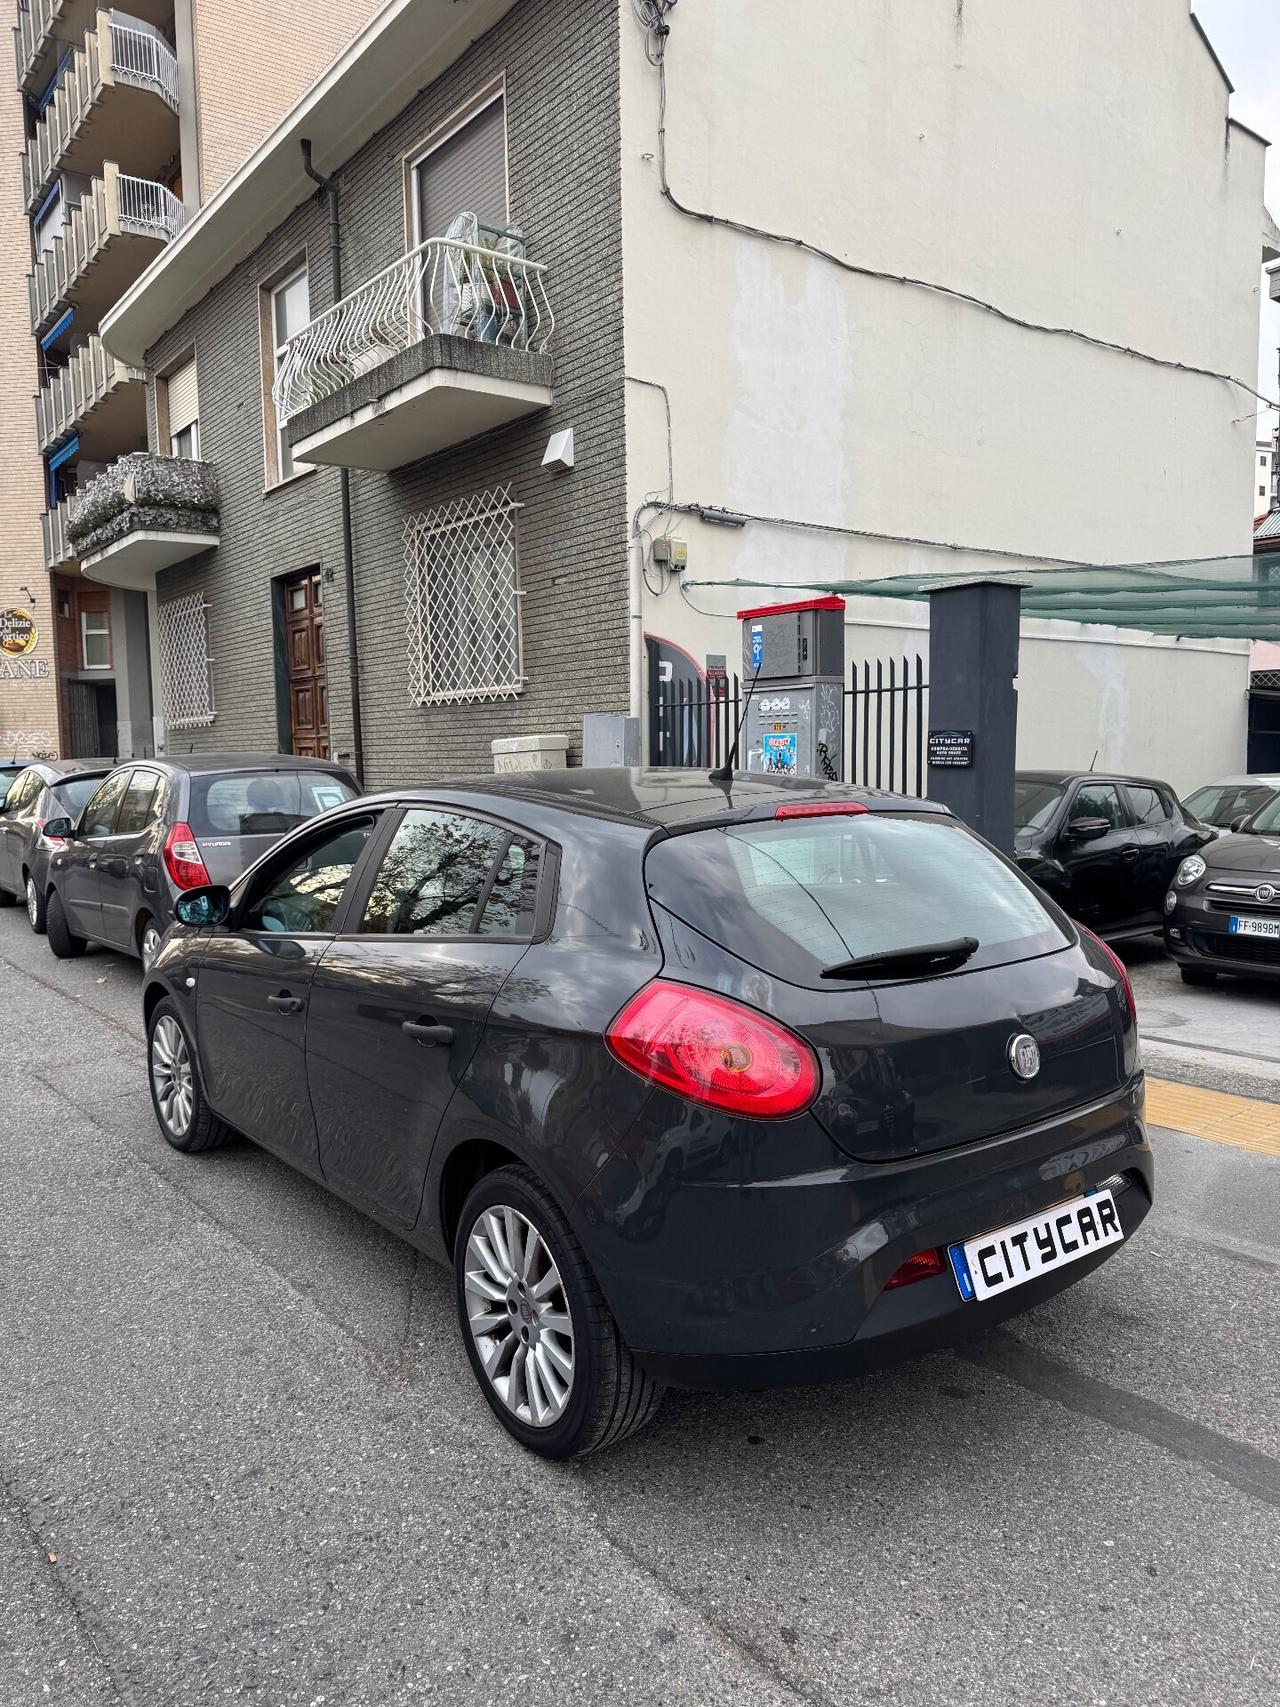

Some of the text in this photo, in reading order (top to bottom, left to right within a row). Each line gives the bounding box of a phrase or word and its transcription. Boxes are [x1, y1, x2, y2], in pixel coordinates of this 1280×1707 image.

[0, 617, 31, 628] Delizie
[0, 659, 49, 679] ANE
[977, 1198, 1120, 1288] CITYCAR
